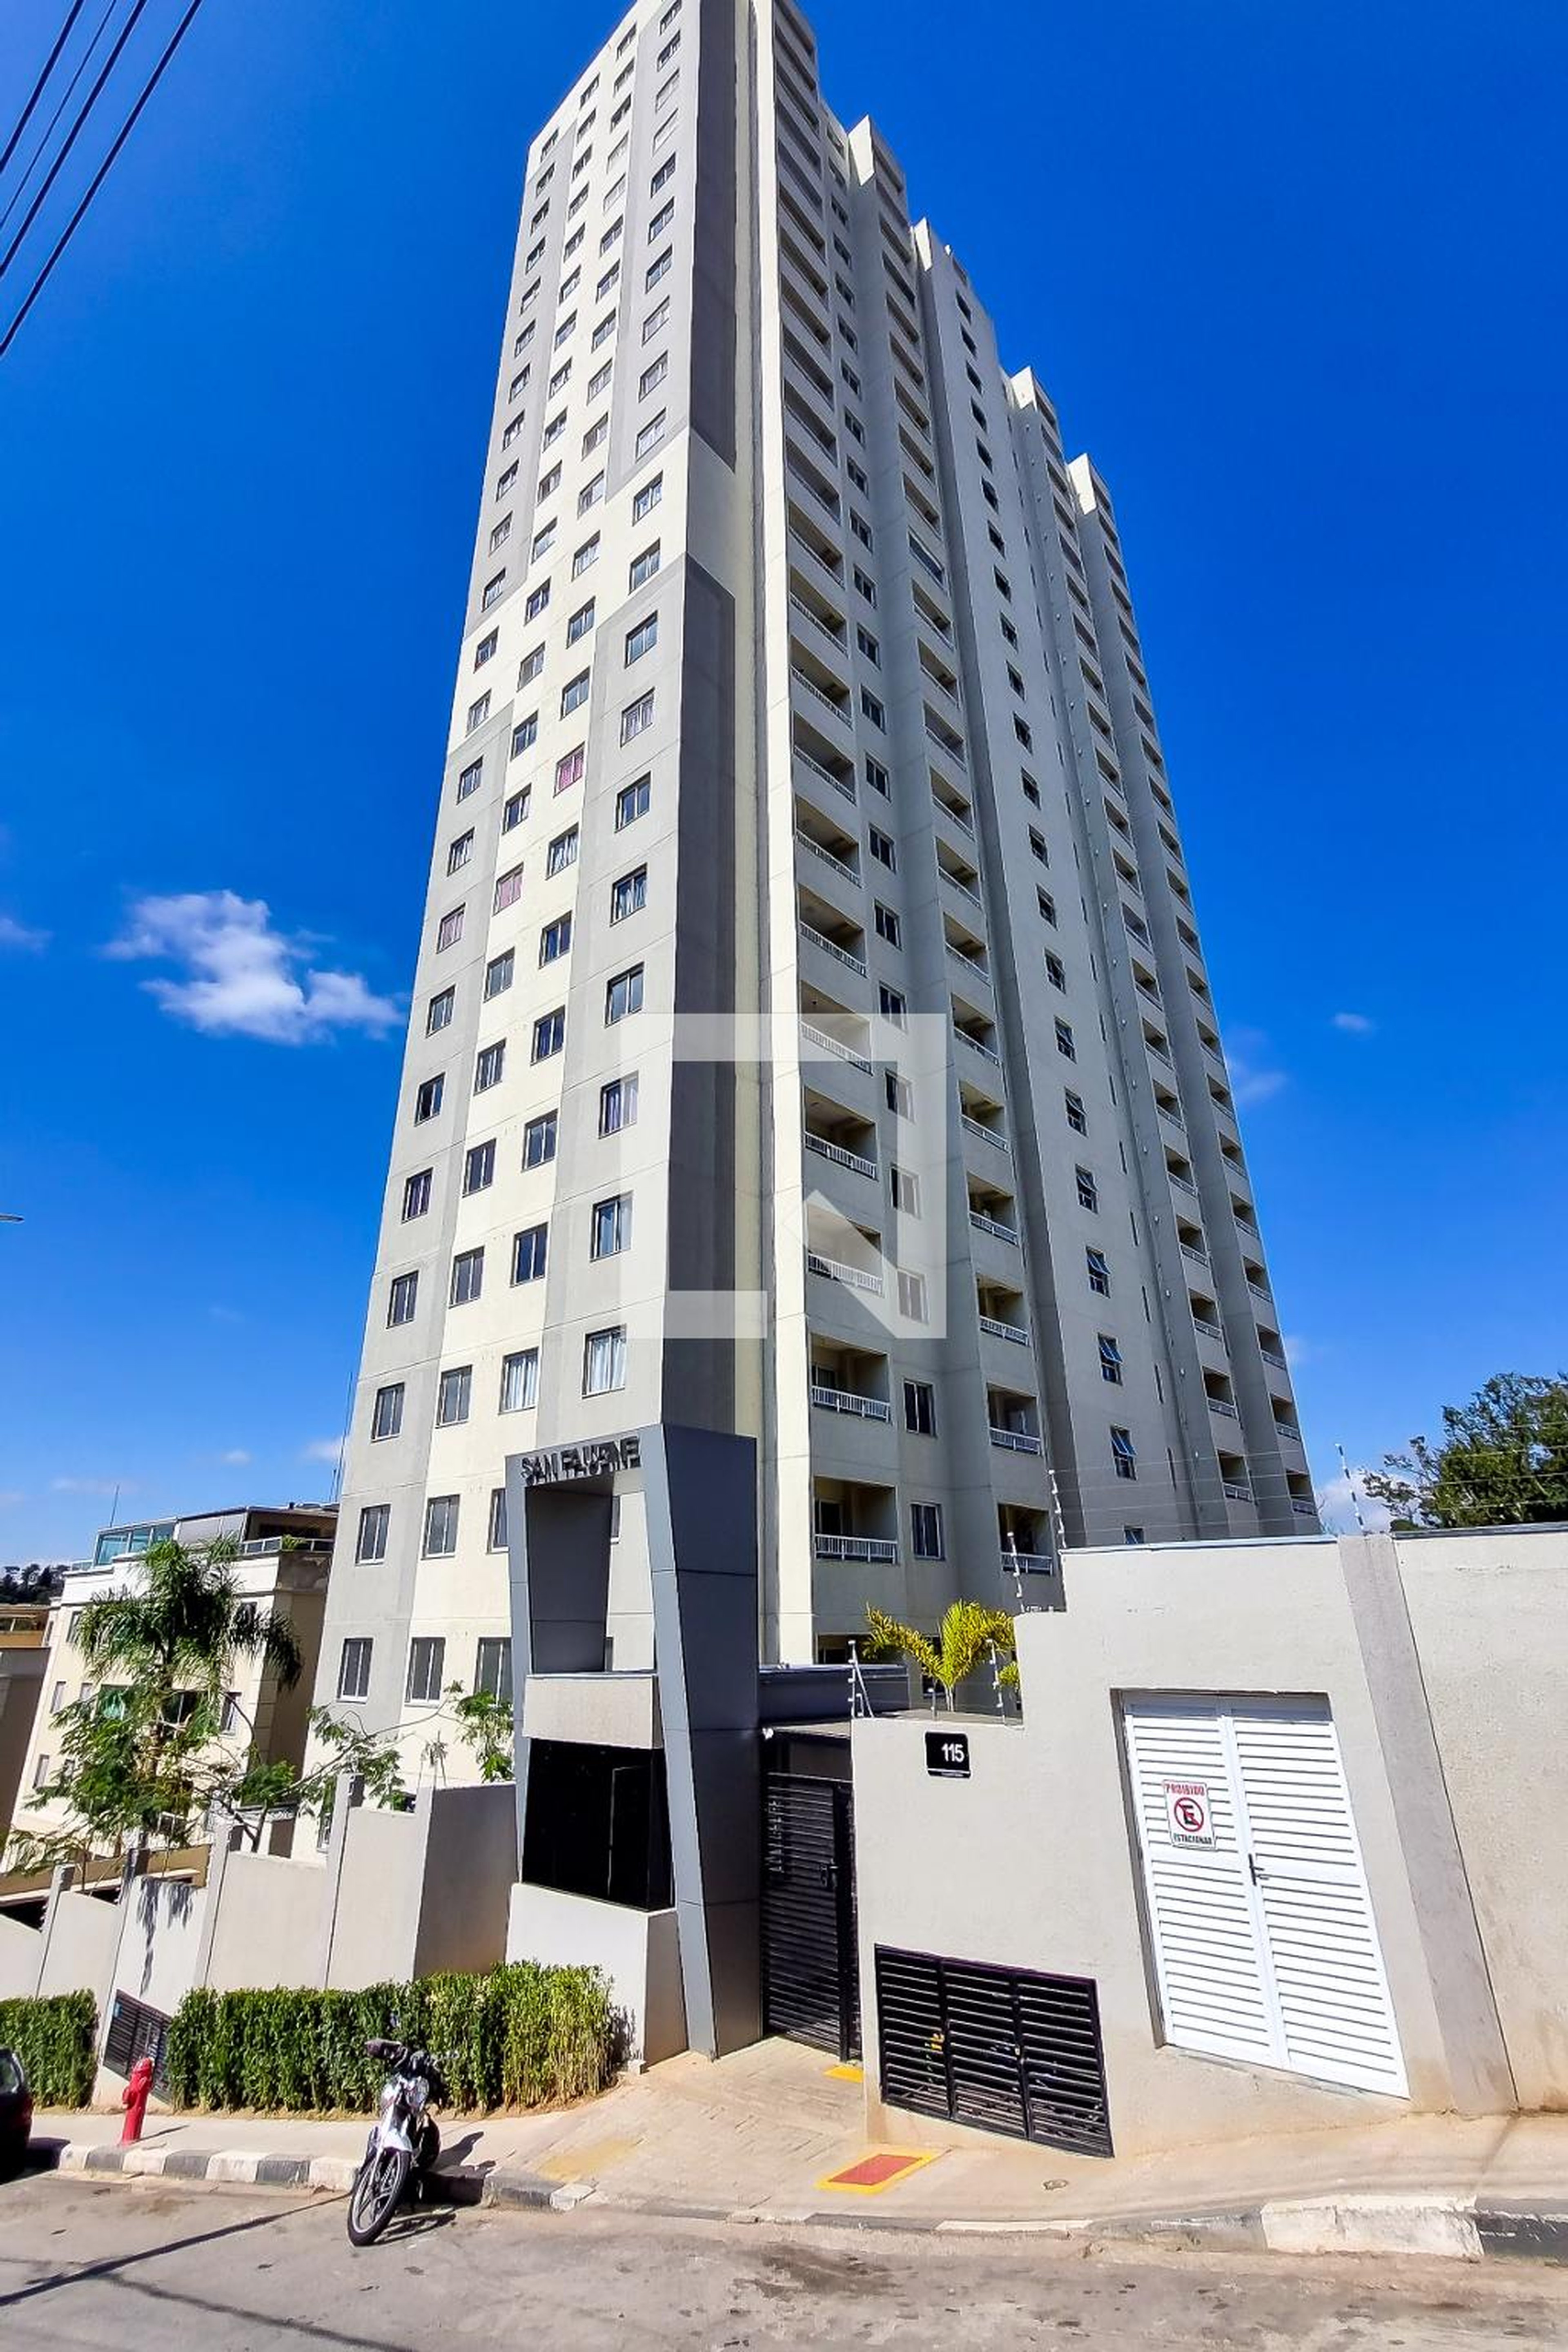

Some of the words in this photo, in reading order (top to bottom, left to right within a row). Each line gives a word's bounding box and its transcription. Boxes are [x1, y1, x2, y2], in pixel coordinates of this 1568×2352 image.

[521, 1453, 558, 1481] SAN
[942, 1743, 964, 1763] 115
[1182, 1805, 1199, 1825] E
